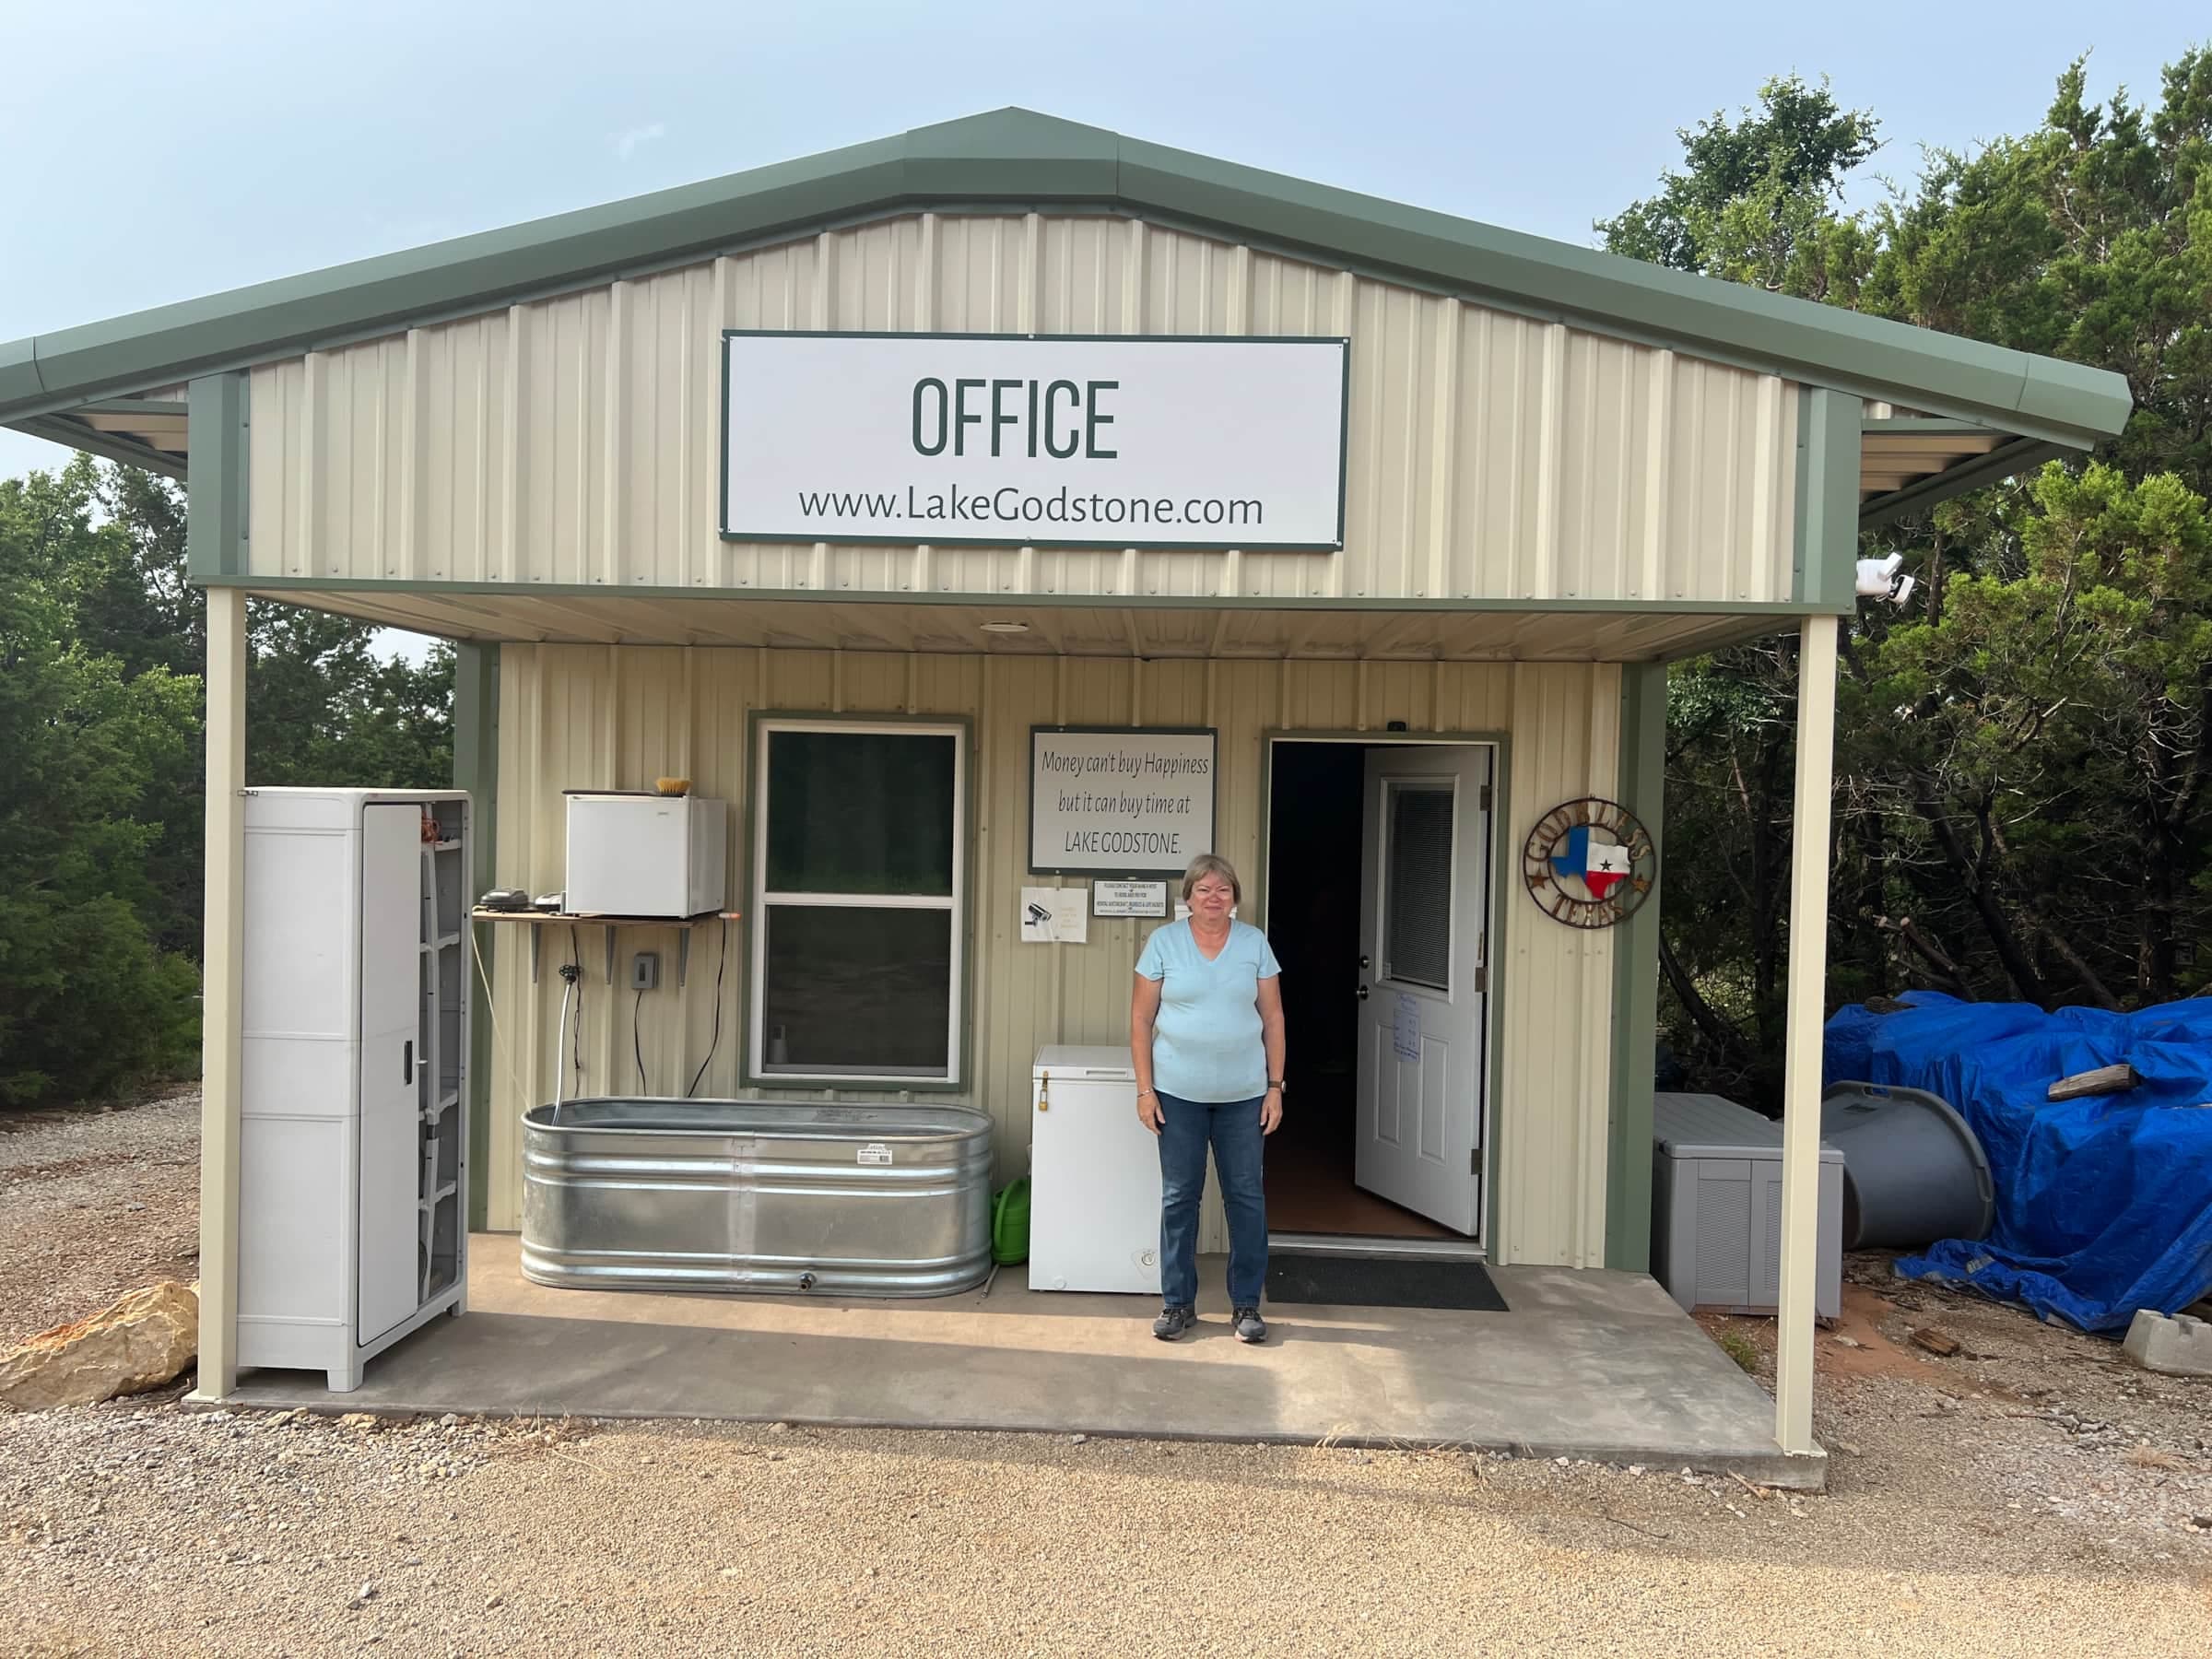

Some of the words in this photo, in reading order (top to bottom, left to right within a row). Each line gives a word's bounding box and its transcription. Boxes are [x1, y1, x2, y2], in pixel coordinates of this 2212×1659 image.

[912, 377, 1119, 459] OFFICE
[798, 484, 1263, 524] www.LakeGodstone.com
[1041, 751, 1085, 778] Money
[1087, 752, 1116, 772] can't
[1118, 749, 1142, 779] buy
[1145, 751, 1209, 779] Happiness
[1058, 789, 1081, 812] but
[1082, 791, 1093, 812] it
[1095, 796, 1117, 812] can
[1119, 790, 1143, 818] buy
[1146, 792, 1174, 814] time
[1177, 795, 1192, 814] at
[1065, 830, 1100, 853] LAKE
[1100, 831, 1182, 854] GODSTONE.
[1551, 890, 1624, 927] TEXAS
